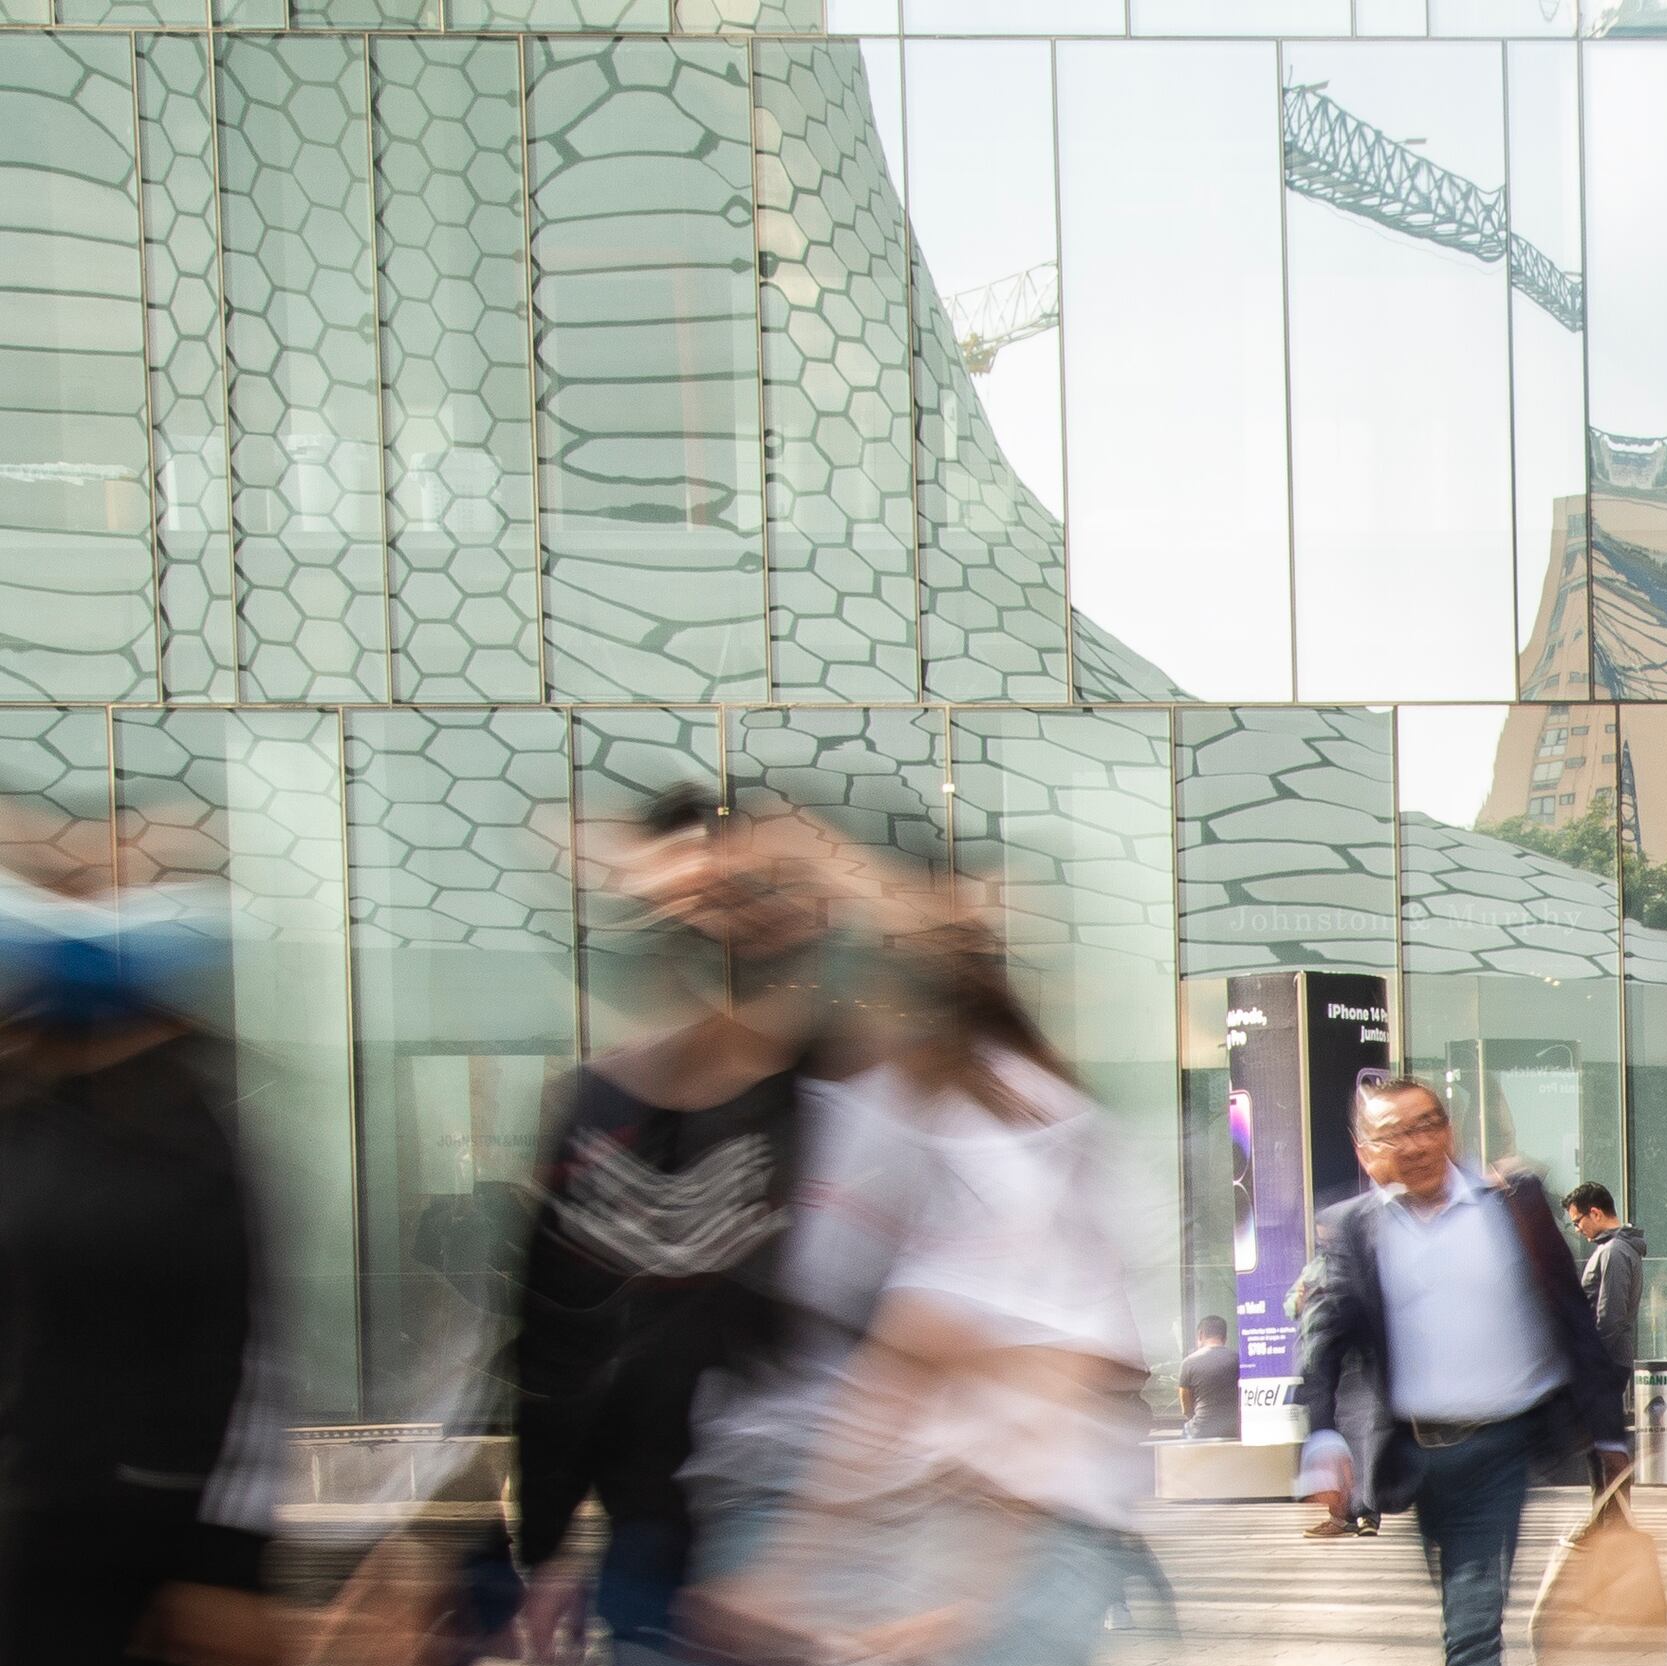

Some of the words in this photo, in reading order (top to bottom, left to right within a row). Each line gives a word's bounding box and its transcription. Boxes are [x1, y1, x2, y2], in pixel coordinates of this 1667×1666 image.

[1229, 904, 1394, 932] Johnston
[1408, 904, 1430, 931] &
[1447, 903, 1582, 936] Murphy
[1327, 1003, 1369, 1021] iPhone
[1370, 1006, 1380, 1022] 14
[1243, 1384, 1281, 1407] telcel
